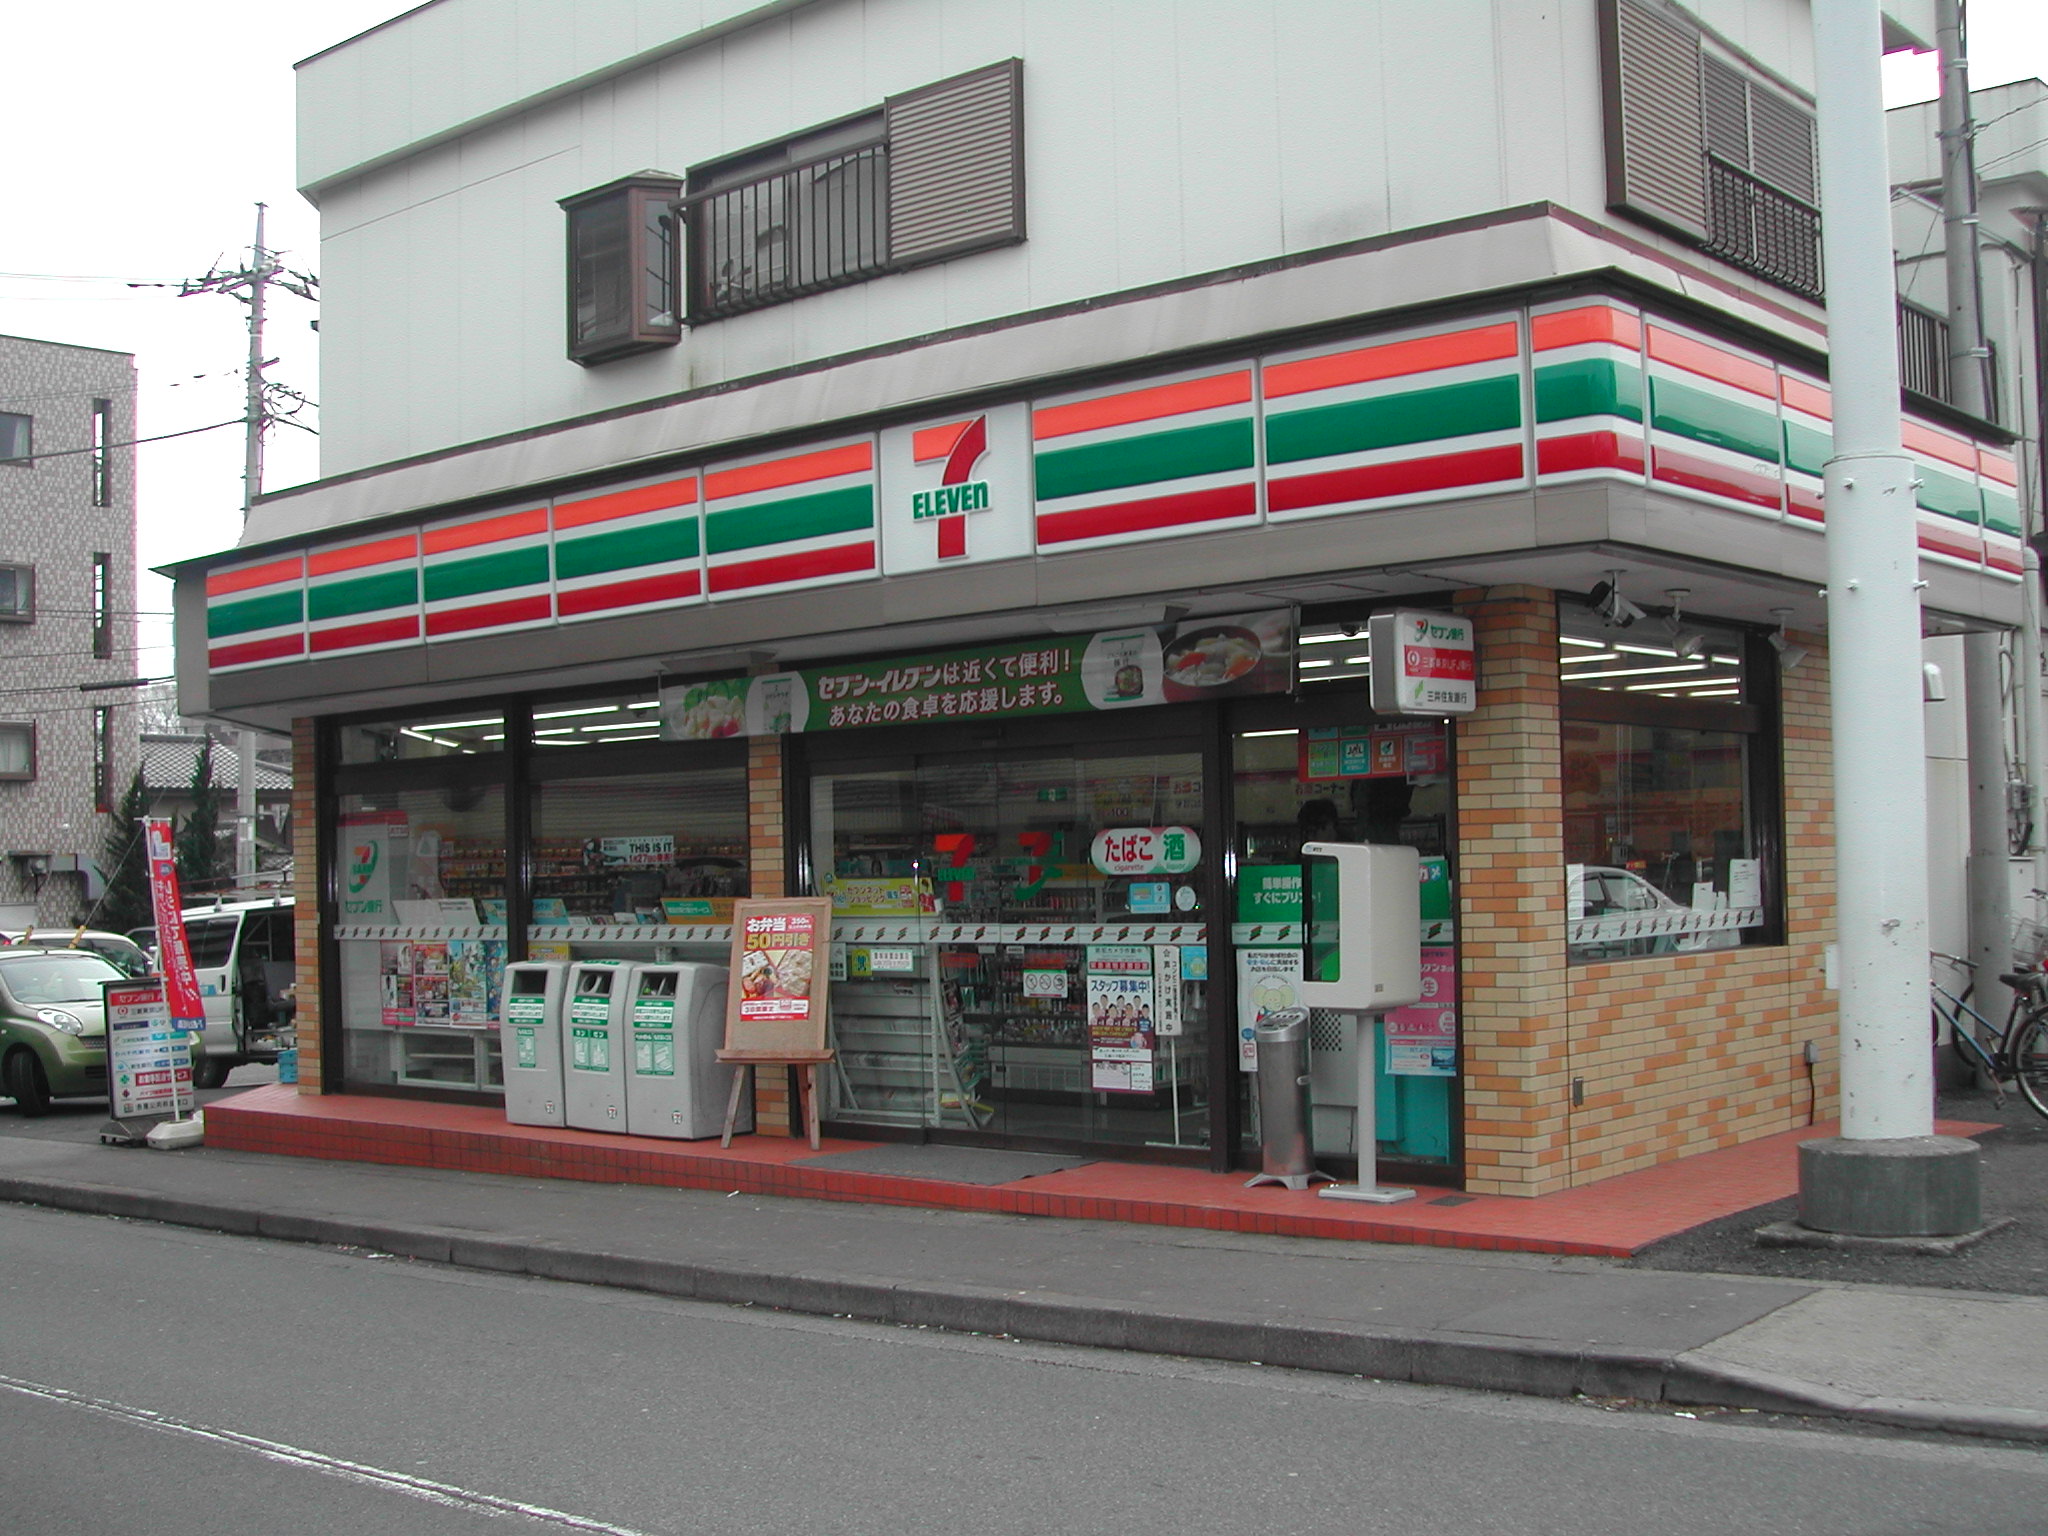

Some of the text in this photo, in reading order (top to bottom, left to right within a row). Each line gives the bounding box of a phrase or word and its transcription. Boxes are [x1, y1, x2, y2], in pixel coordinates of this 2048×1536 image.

[913, 415, 986, 559] 7
[829, 681, 1063, 727] あなたの食卓を応援します。
[629, 843, 650, 853] THIS
[652, 842, 661, 853] IS
[663, 842, 672, 852] IT
[1105, 833, 1185, 862] たばこ 酒
[935, 834, 975, 901] 7
[1253, 891, 1321, 905] すぐにプリン!
[747, 917, 786, 933] お弁当
[747, 932, 810, 950] 50円引き
[1091, 979, 1150, 994] スタッフ募集中!
